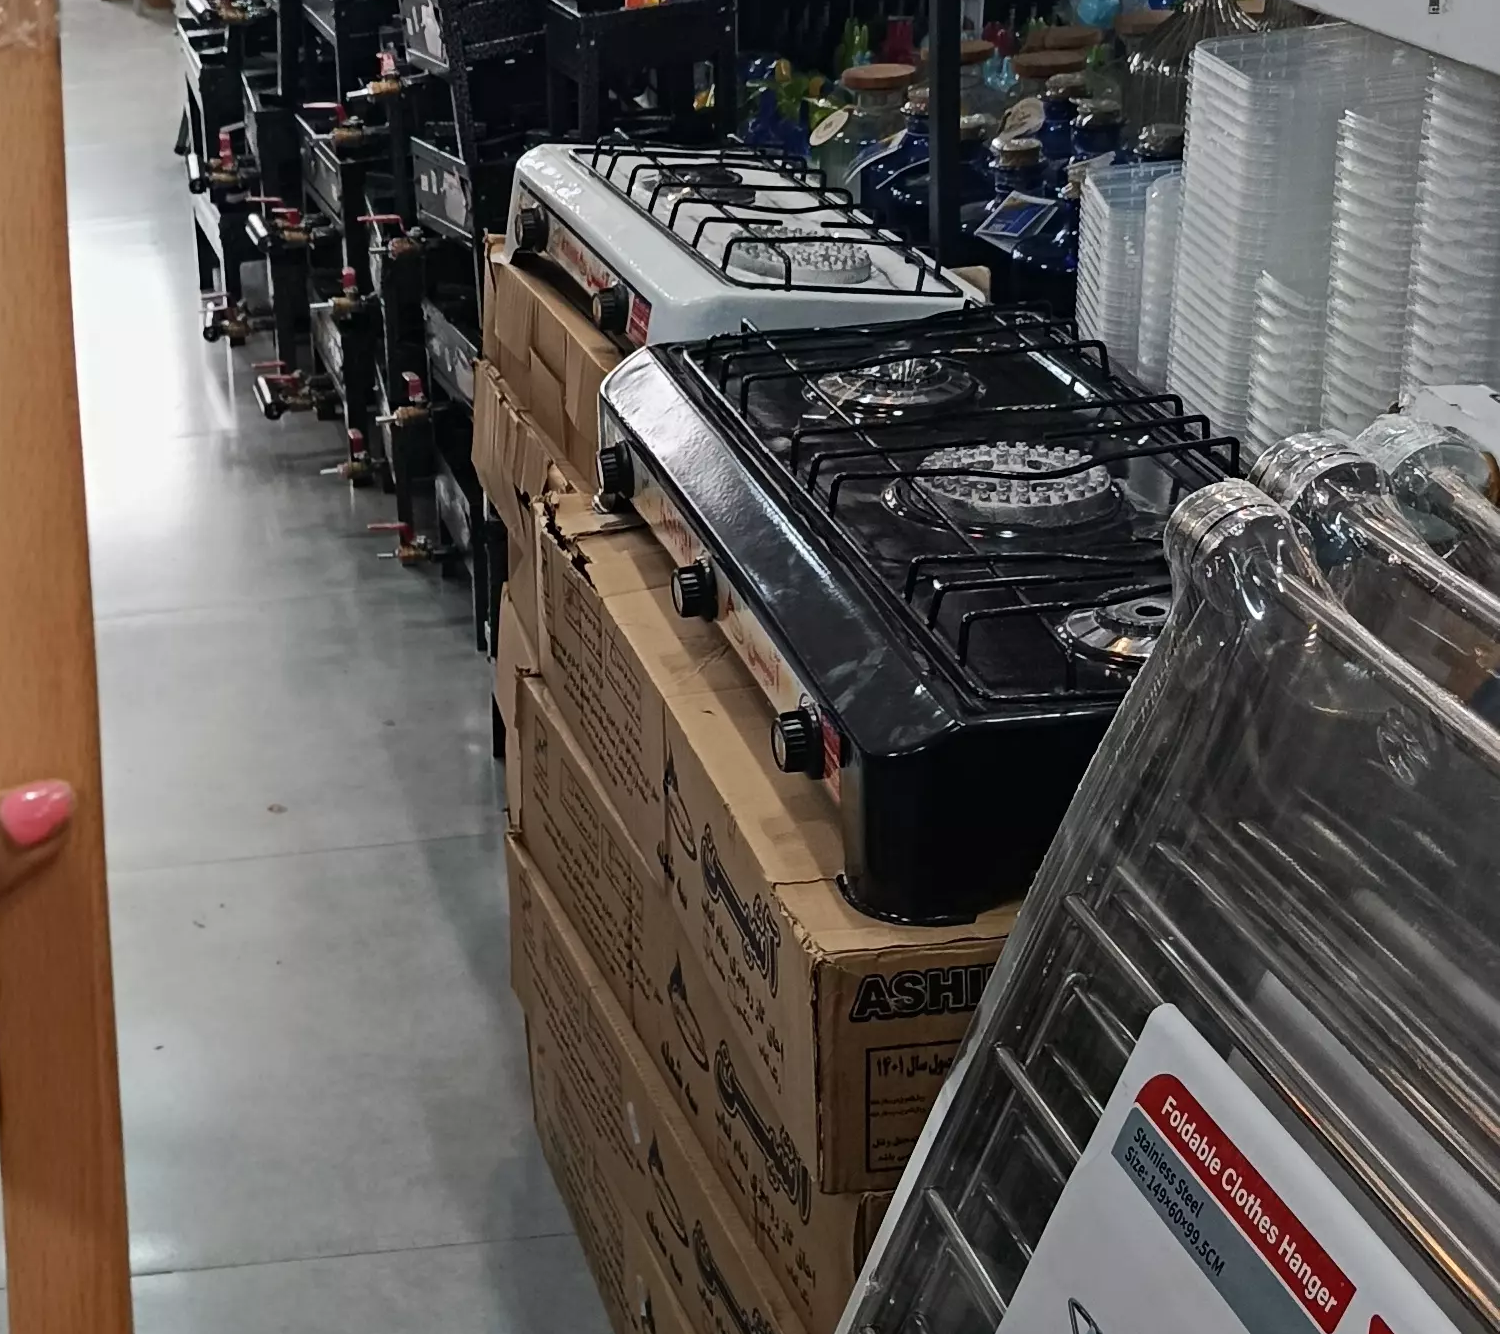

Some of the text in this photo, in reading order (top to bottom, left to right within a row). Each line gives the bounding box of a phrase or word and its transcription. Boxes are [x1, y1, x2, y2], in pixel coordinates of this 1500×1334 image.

[849, 963, 997, 1023] ASHI
[1124, 1145, 1149, 1181] Size:
[1160, 1095, 1338, 1313] Foldable Clothes Hanger
[1174, 1178, 1205, 1219] Steel
